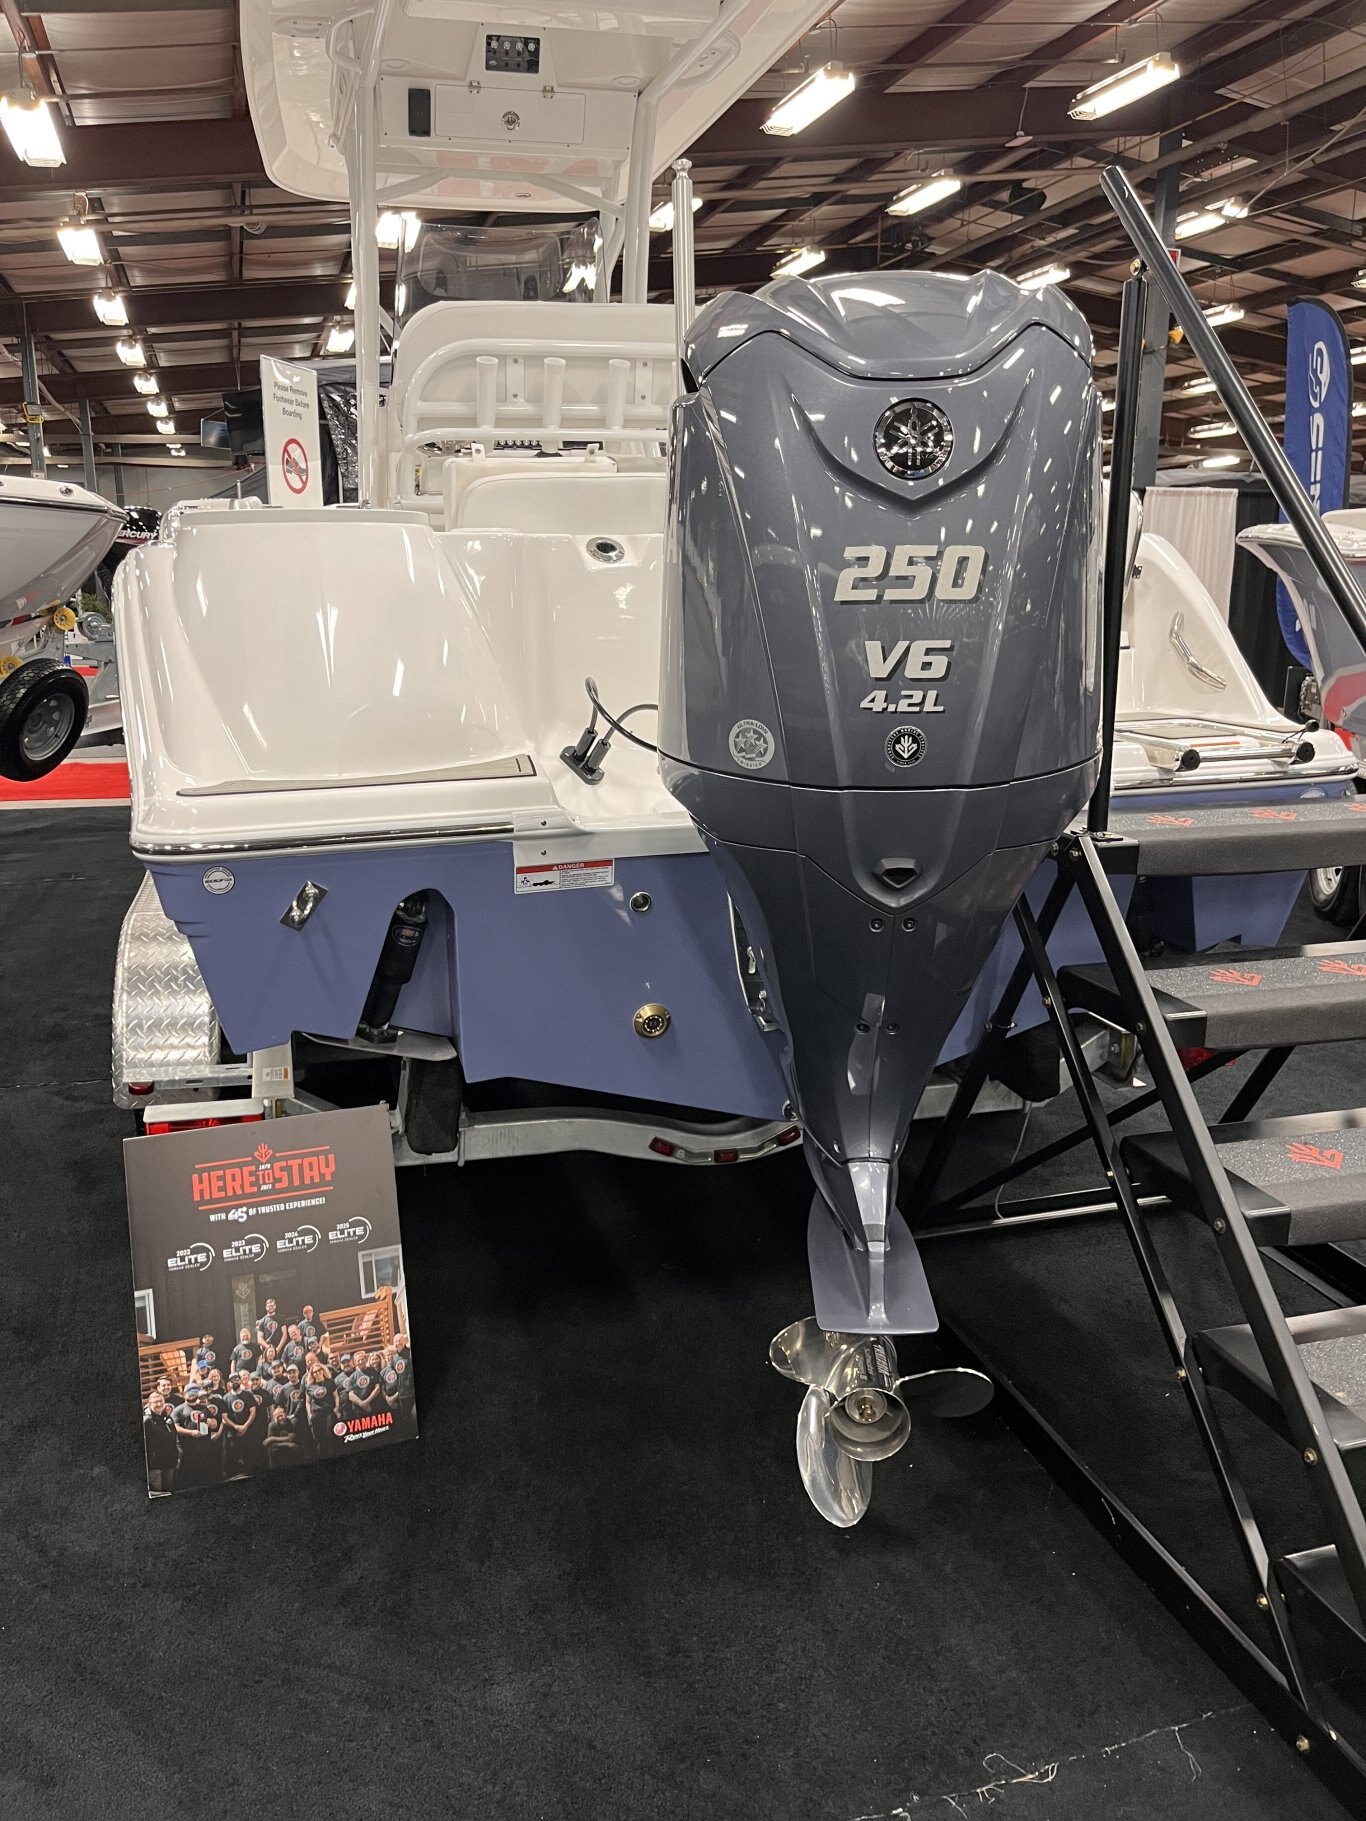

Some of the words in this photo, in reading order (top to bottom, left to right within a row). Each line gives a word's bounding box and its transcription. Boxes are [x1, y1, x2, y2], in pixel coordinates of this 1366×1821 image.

[273, 381, 289, 392] Please
[290, 385, 307, 397] Remove
[273, 392, 294, 405] Footwear
[295, 398, 309, 409] Before
[282, 407, 302, 420] Boarding
[119, 529, 158, 539] ERCURY
[834, 544, 988, 603] 250
[865, 640, 953, 680] V6
[860, 690, 945, 713] 4.2L
[756, 723, 769, 735] LOW
[192, 1165, 258, 1201] HERE
[257, 1170, 273, 1185] TO
[273, 1154, 336, 1189] STAY
[209, 1213, 226, 1222] WITH
[227, 1206, 248, 1222] 45
[248, 1208, 257, 1216] OF
[257, 1202, 285, 1214] TRUSTED
[286, 1197, 326, 1210] EXPERIENCE!
[284, 1231, 299, 1239] 2024
[328, 1226, 365, 1240] ELITE
[276, 1235, 314, 1249] ELITE
[176, 1249, 191, 1257] 2022
[222, 1244, 261, 1258] ELITE
[167, 1253, 207, 1267] ELITE
[347, 1412, 393, 1433] YAMAHA
